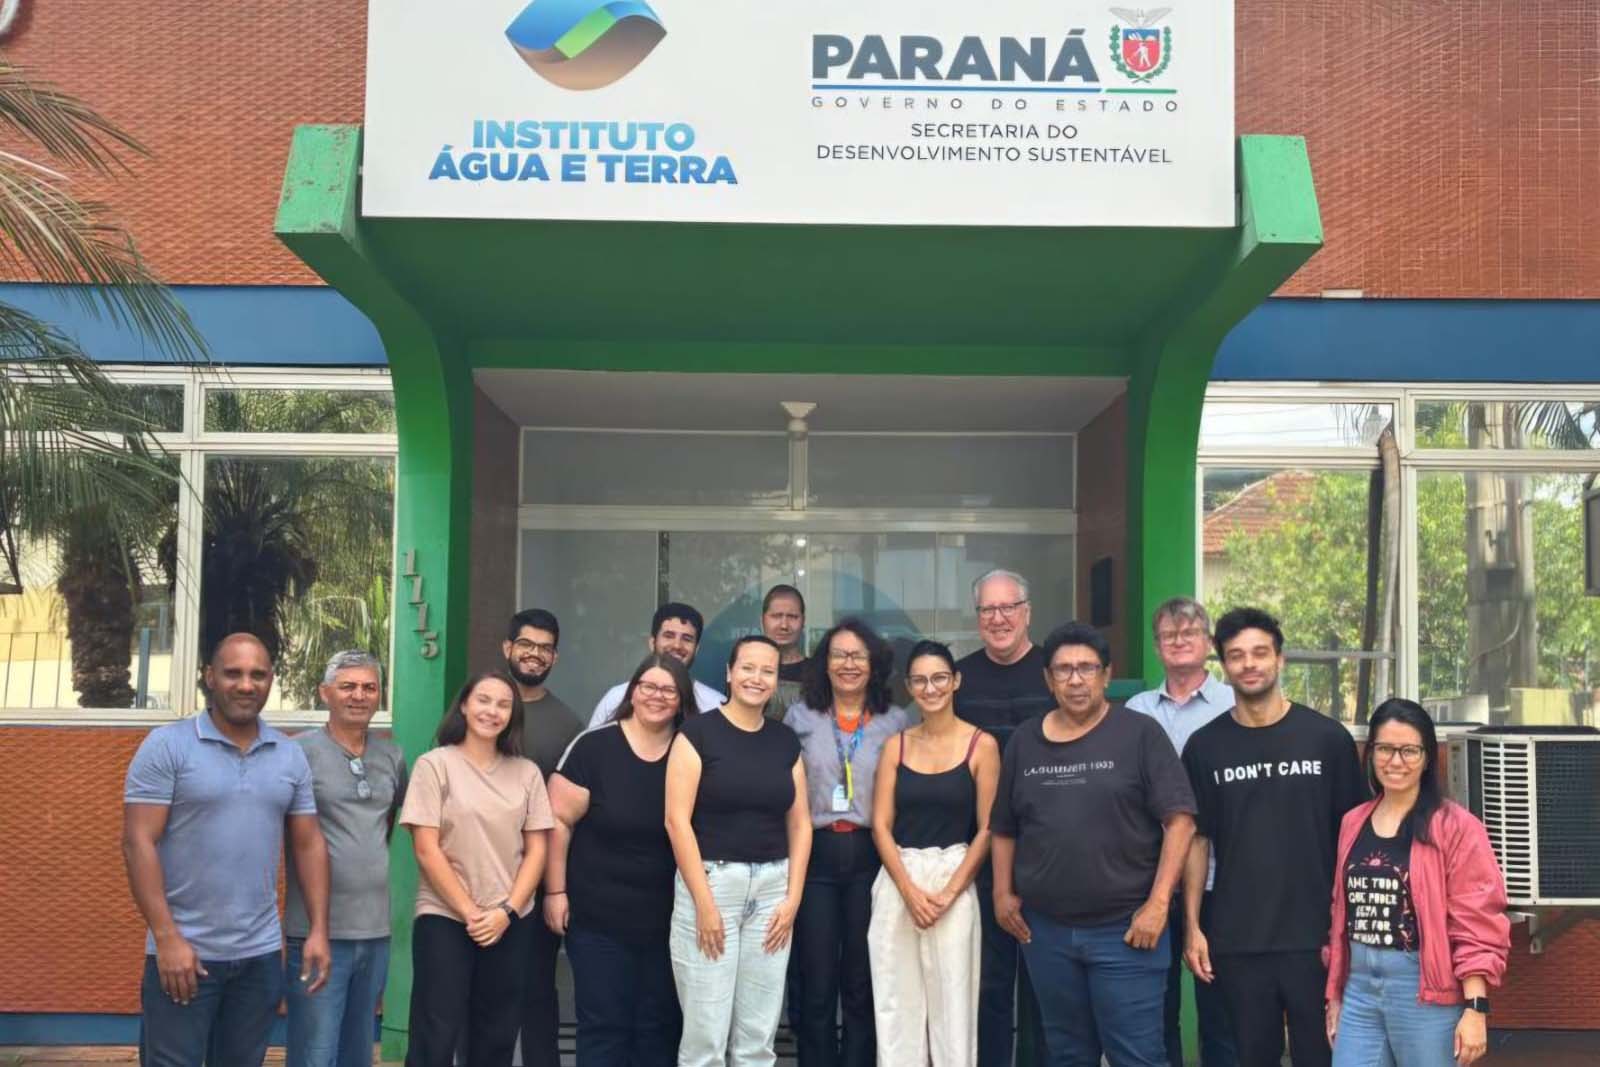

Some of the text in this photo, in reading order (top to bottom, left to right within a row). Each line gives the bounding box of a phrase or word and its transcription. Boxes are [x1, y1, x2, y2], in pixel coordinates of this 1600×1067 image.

[811, 28, 1100, 83] PARANÁ
[811, 96, 1179, 113] GOVERNO DO ESTADO
[472, 119, 695, 152] INSTITUTO
[911, 123, 1078, 139] SECRETARIA DO
[428, 143, 738, 185] ÁGUA E TERRA
[816, 143, 1173, 164] DESENVOLVIMENTO SUSTENTÁVEL
[1213, 759, 1322, 785] I DON'T CARE
